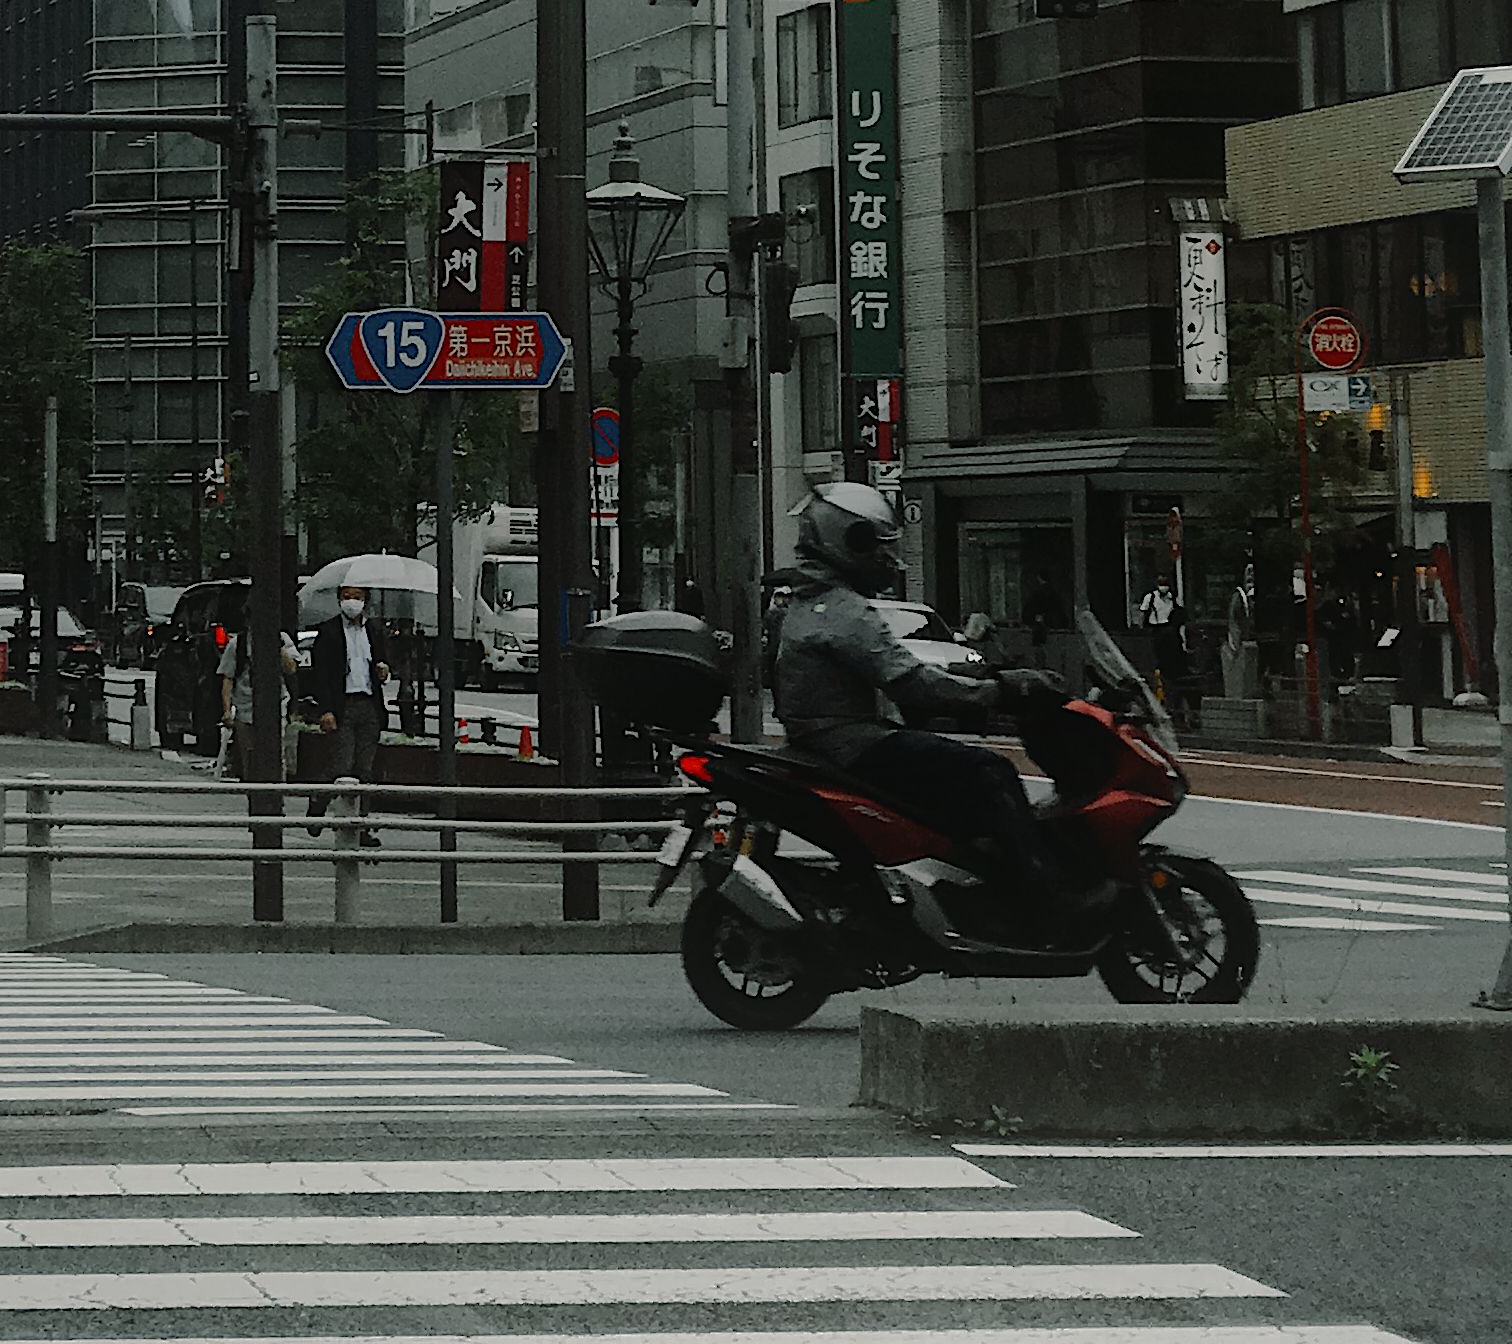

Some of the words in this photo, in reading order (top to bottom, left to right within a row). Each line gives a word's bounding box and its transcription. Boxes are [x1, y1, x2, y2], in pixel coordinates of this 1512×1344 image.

[846, 89, 890, 331] りそな銀行
[440, 190, 482, 294] 大門
[377, 320, 428, 368] 15
[448, 323, 537, 358] 第一京浜
[1315, 332, 1355, 353] 消火栓
